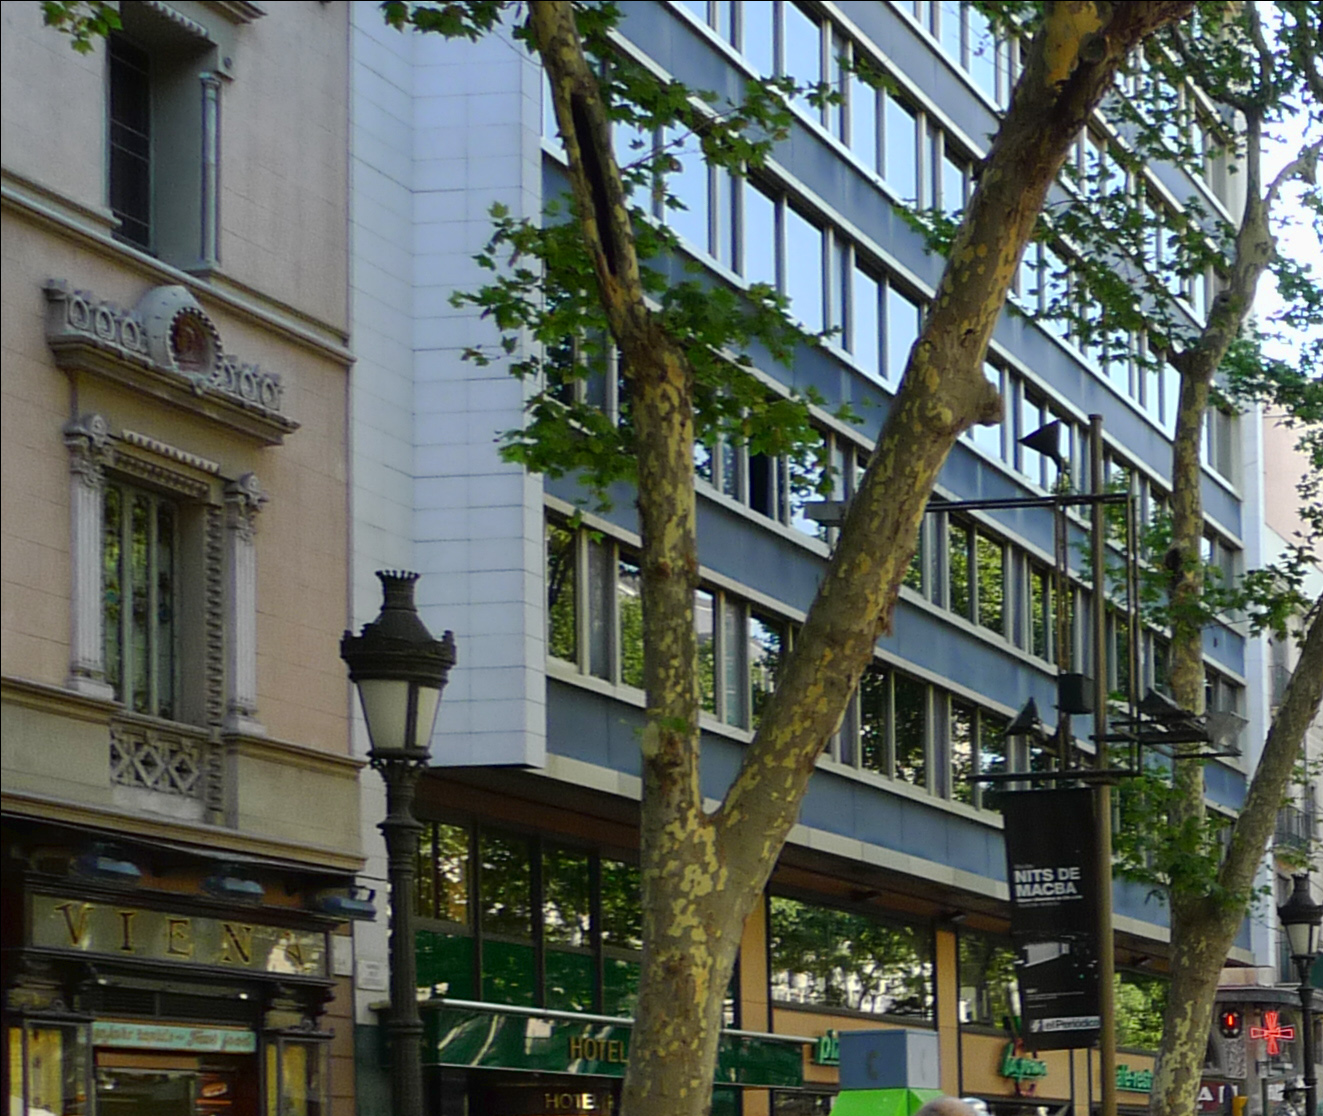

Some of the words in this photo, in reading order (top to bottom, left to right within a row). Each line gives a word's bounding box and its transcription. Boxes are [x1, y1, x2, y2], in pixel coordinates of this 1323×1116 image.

[1014, 868, 1055, 883] NITS
[1057, 866, 1081, 881] DE
[1015, 881, 1078, 898] MACBA
[569, 1036, 629, 1063] HOTEL
[545, 1093, 600, 1110] HOTE
